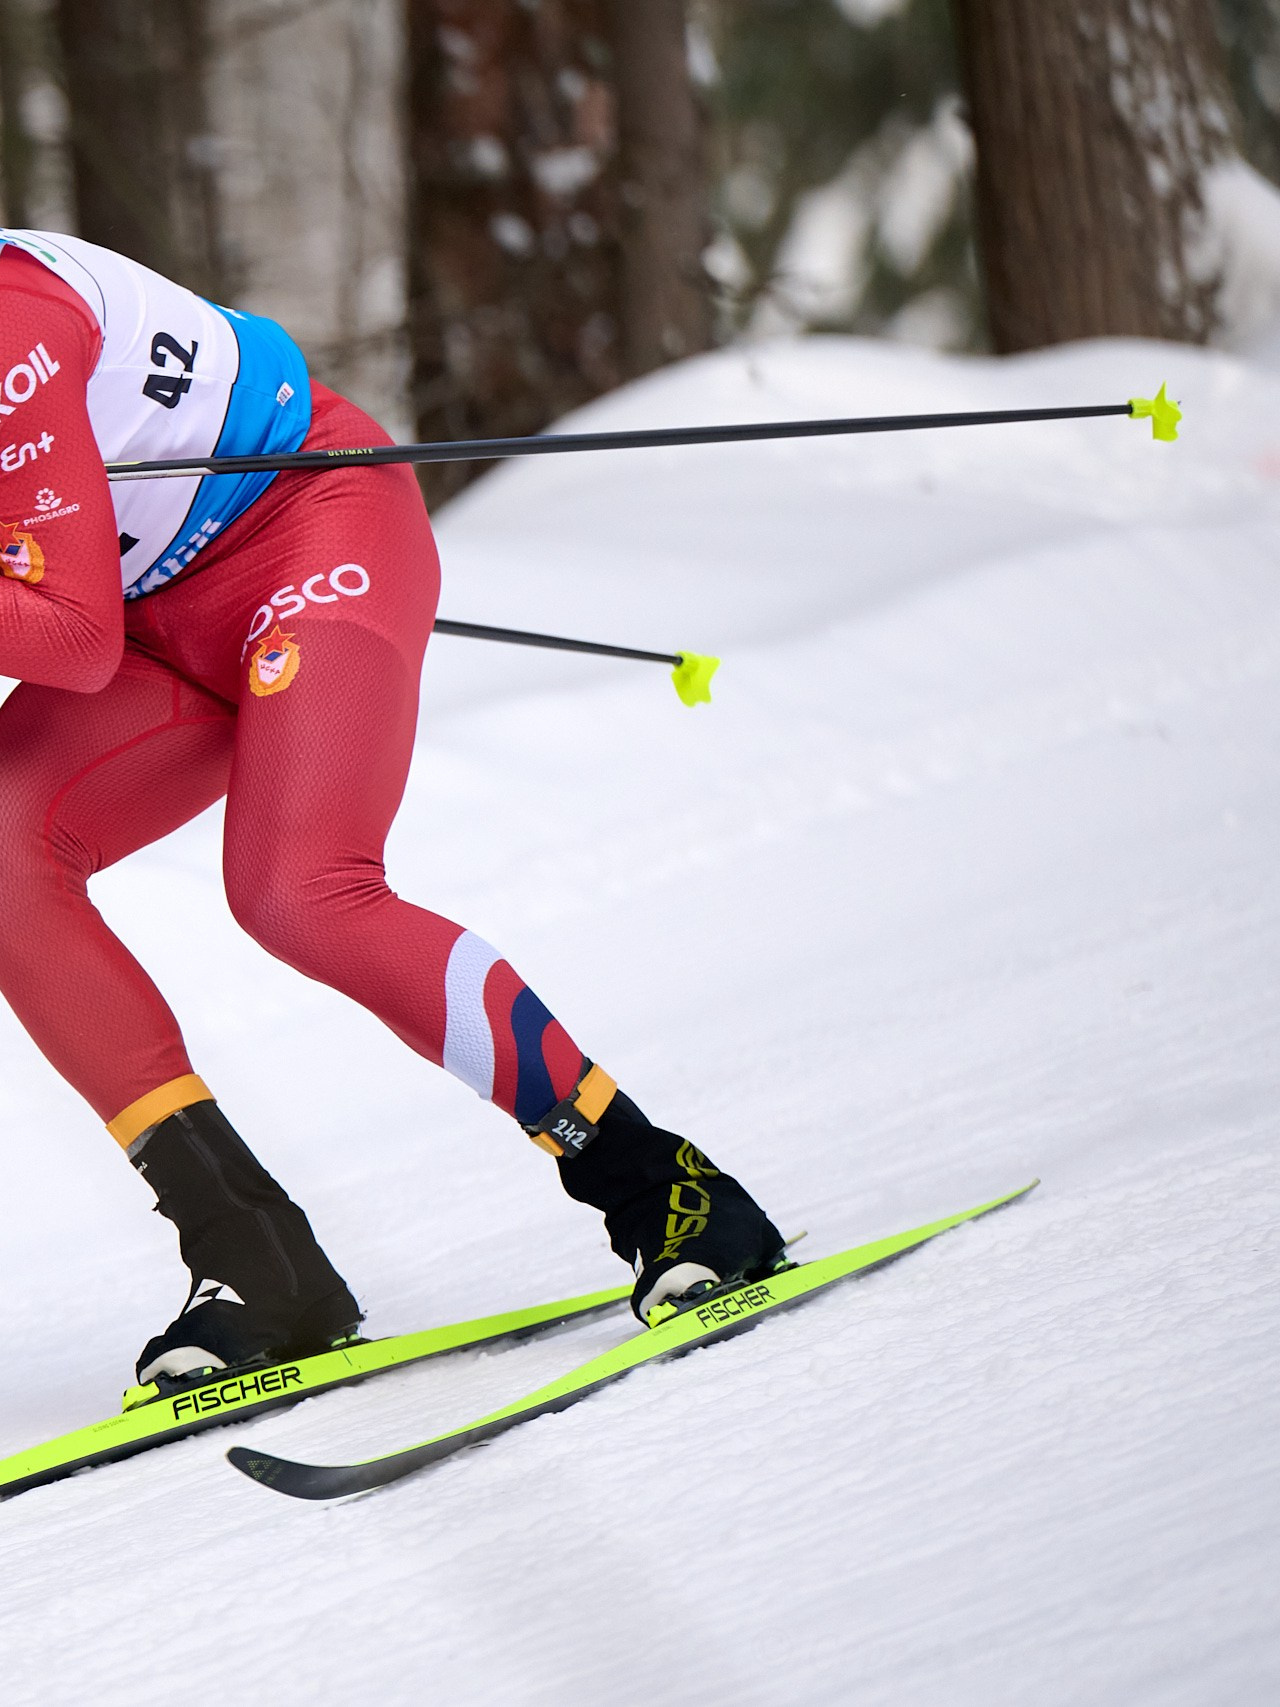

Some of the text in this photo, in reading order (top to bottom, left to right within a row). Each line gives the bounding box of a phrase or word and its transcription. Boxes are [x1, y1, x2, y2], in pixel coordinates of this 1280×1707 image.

[142, 331, 199, 410] 42
[0, 431, 55, 472] En+
[327, 448, 375, 458] ULTIMATE
[23, 503, 80, 527] PHOSAGRO
[240, 563, 371, 665] OSCO
[551, 1118, 588, 1150] 242
[696, 1285, 776, 1329] FISCHER
[172, 1366, 304, 1420] FISCHER
